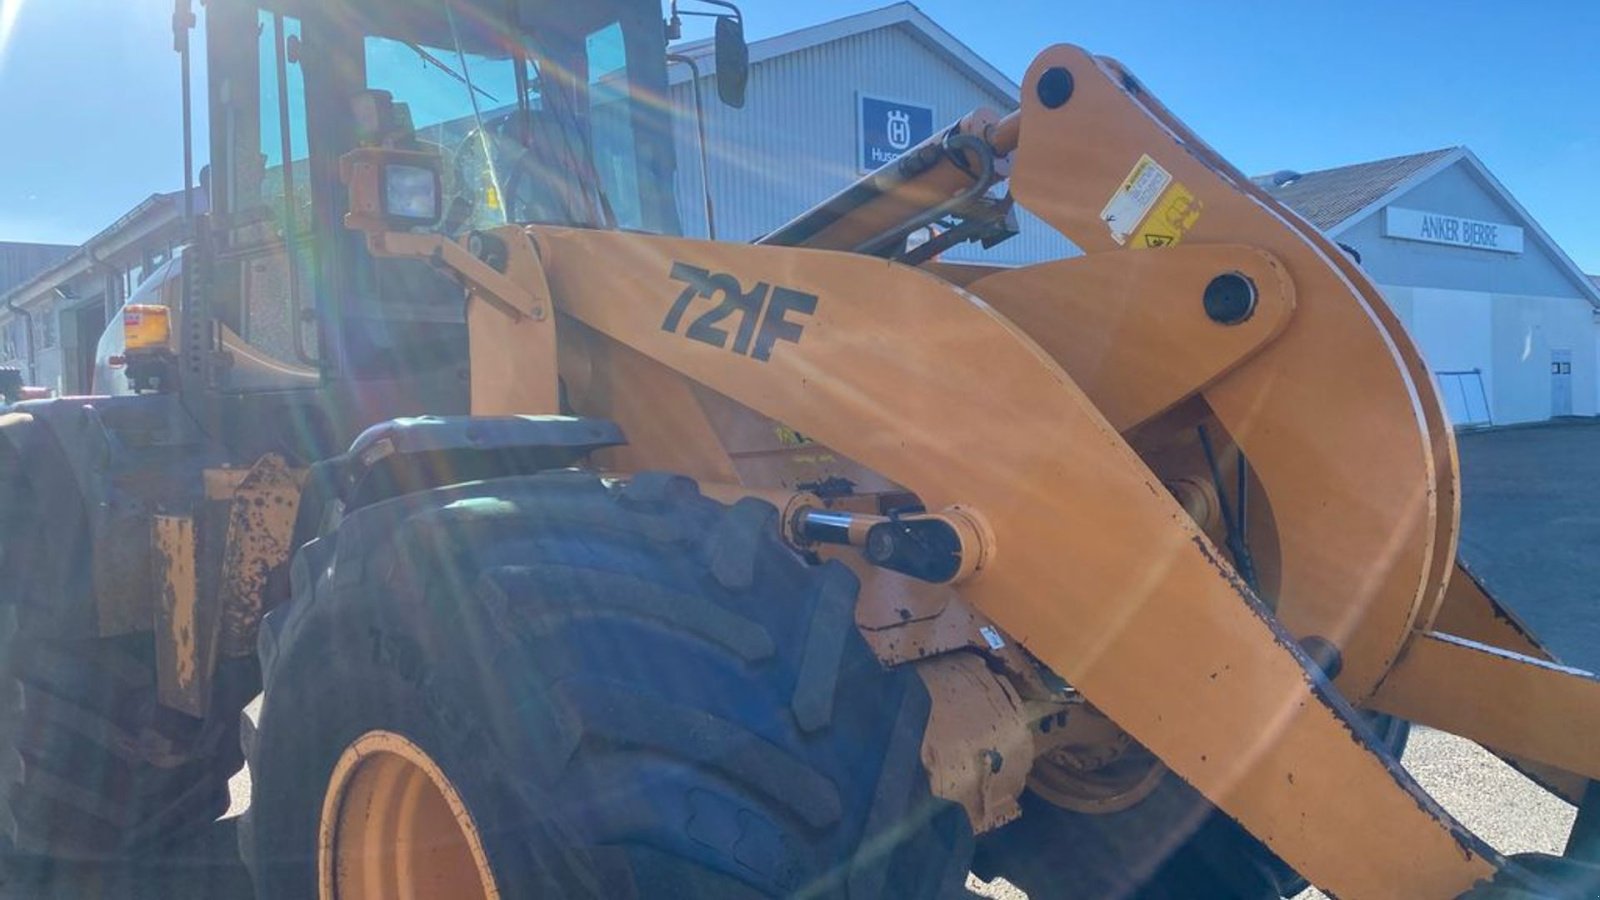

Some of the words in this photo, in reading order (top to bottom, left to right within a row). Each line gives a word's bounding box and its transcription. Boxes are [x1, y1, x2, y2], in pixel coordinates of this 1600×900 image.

[1420, 214, 1459, 242] ANKER
[1462, 221, 1498, 247] BJERRE
[661, 261, 819, 363] 721F
